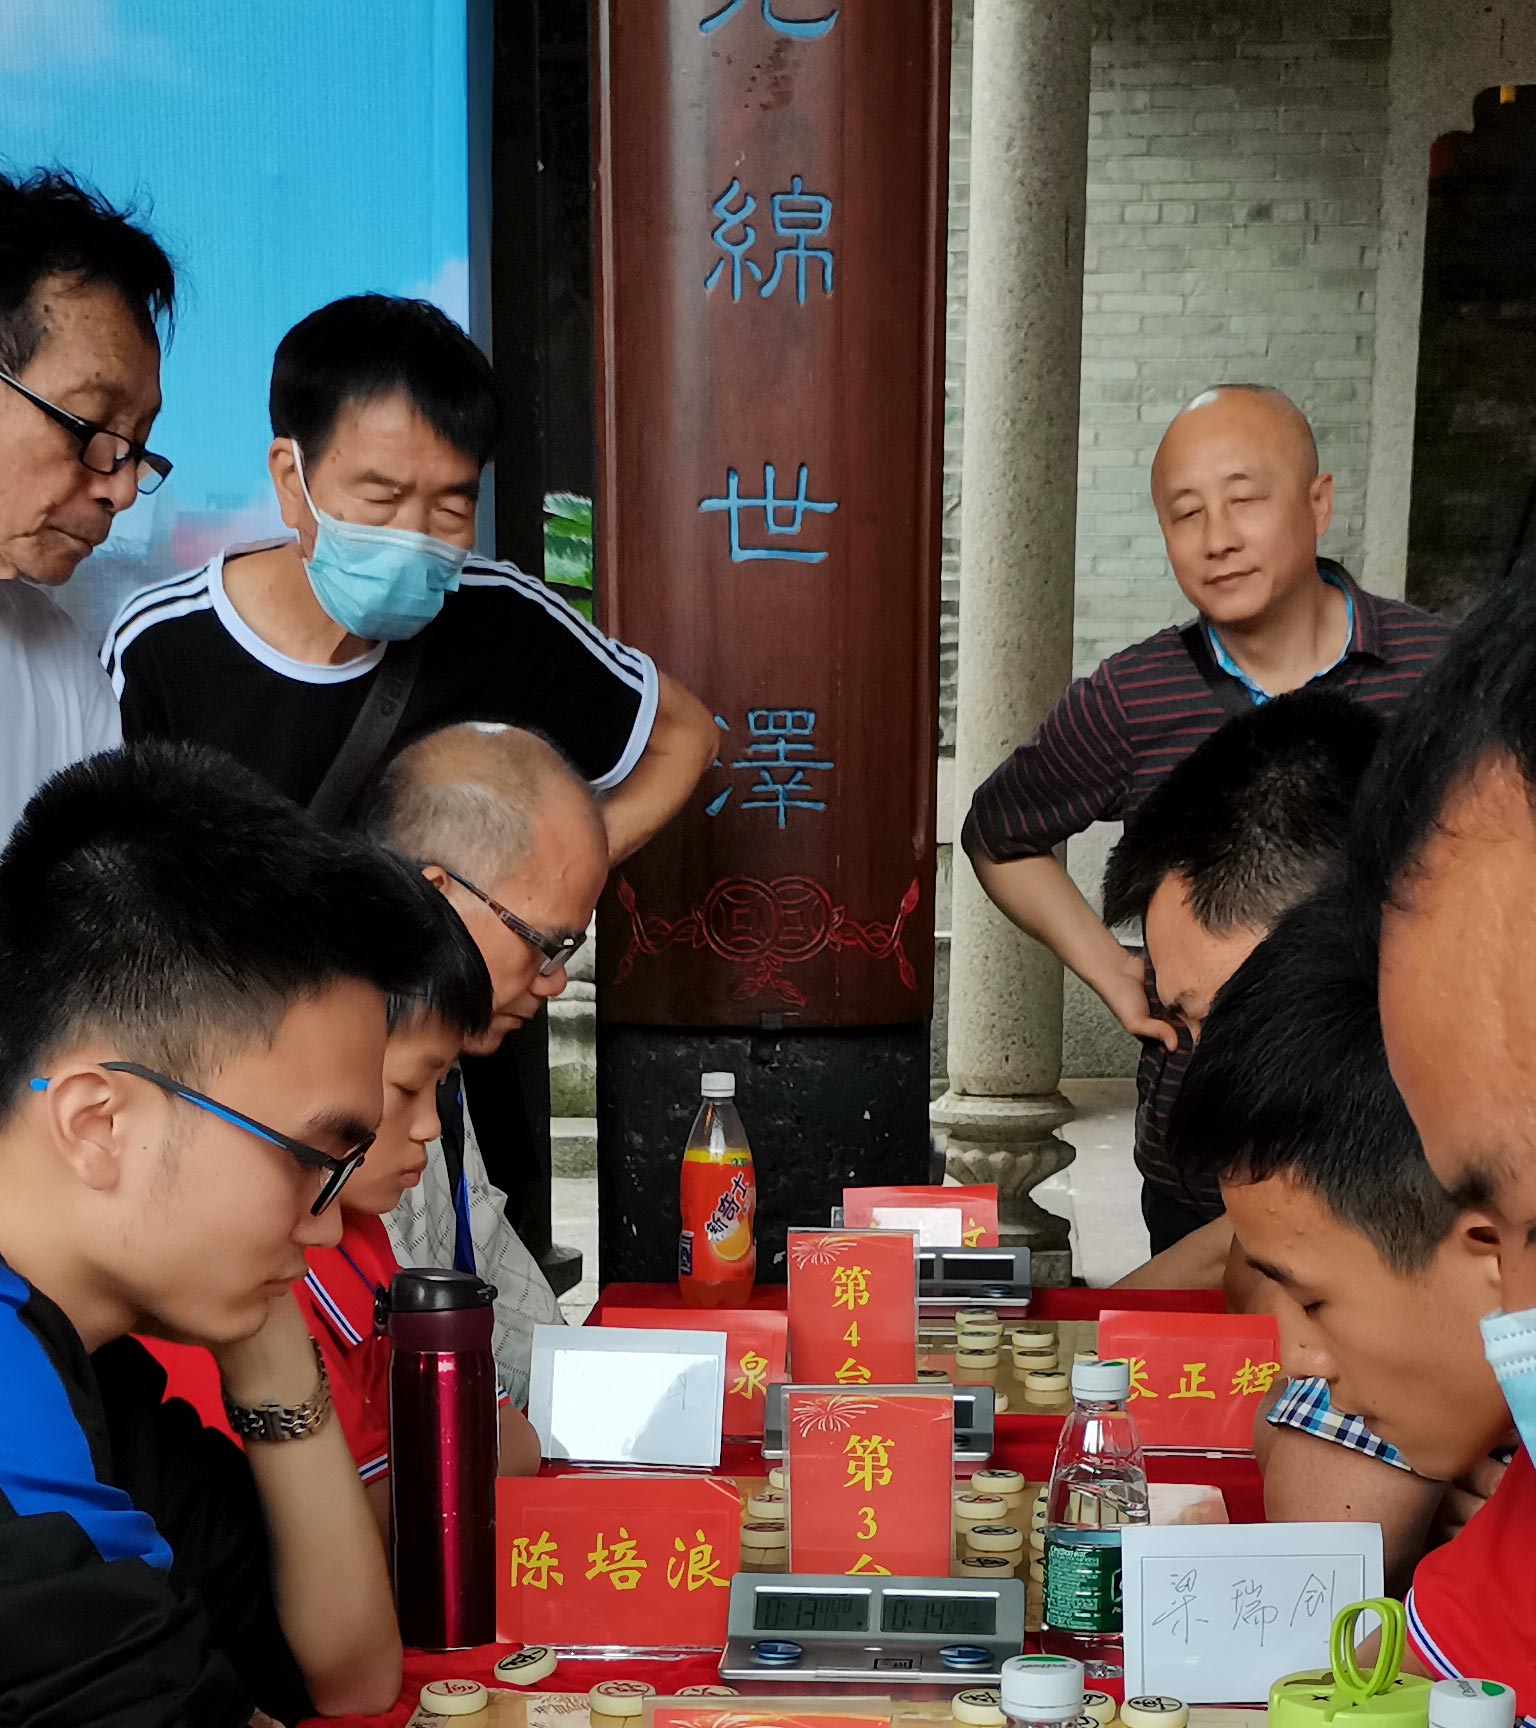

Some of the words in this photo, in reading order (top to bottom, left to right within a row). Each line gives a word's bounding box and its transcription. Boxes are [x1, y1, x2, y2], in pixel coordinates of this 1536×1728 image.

[698, 0, 838, 829] 綿世澤
[832, 1266, 872, 1384] 第4台
[729, 1350, 768, 1400] 泉
[511, 1527, 731, 1591] 陈培浪
